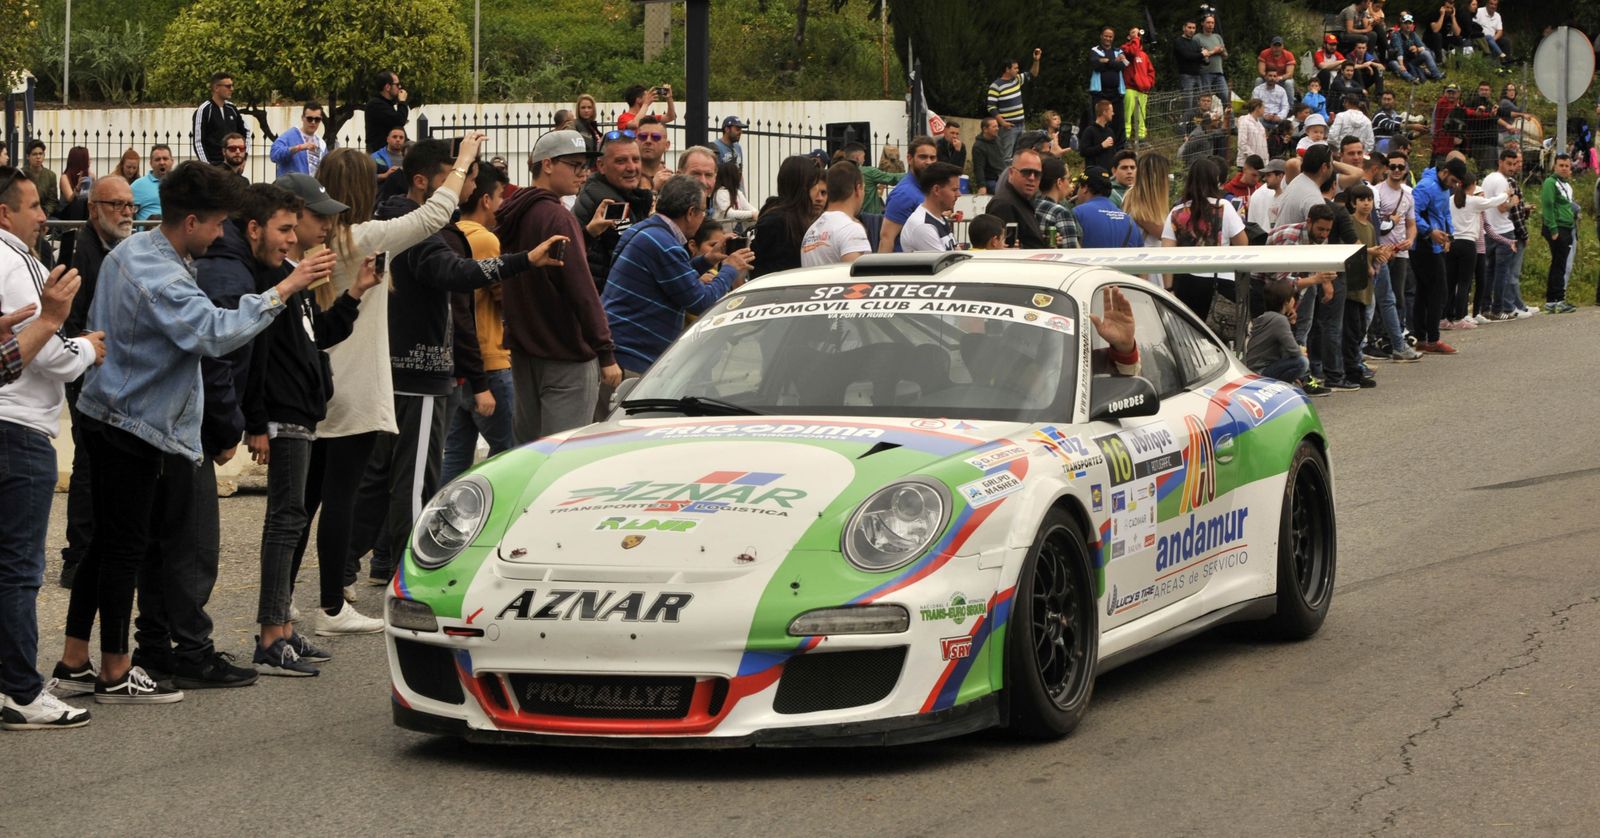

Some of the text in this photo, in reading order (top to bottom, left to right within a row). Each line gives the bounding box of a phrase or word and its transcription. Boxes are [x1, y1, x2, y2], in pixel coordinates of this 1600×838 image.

[731, 301, 1014, 321] AUTOMOVIL CLUB ALMERIA
[1108, 394, 1145, 413] LOURDES
[645, 424, 886, 438] FRIGODIMA
[1062, 455, 1103, 474] TRANSPORTES
[1103, 437, 1132, 483] 16
[982, 474, 1011, 488] GRUPO
[984, 479, 1020, 496] MASHER
[550, 503, 670, 514] TRANSPORTES
[696, 504, 789, 517] LOGISTICA
[1156, 507, 1249, 572] andamur
[1153, 551, 1248, 600] AREAS de SERVICIO
[495, 588, 695, 622] AZNAR
[920, 605, 966, 621] TRANS-EURO
[526, 681, 683, 706] PRORALLYE
